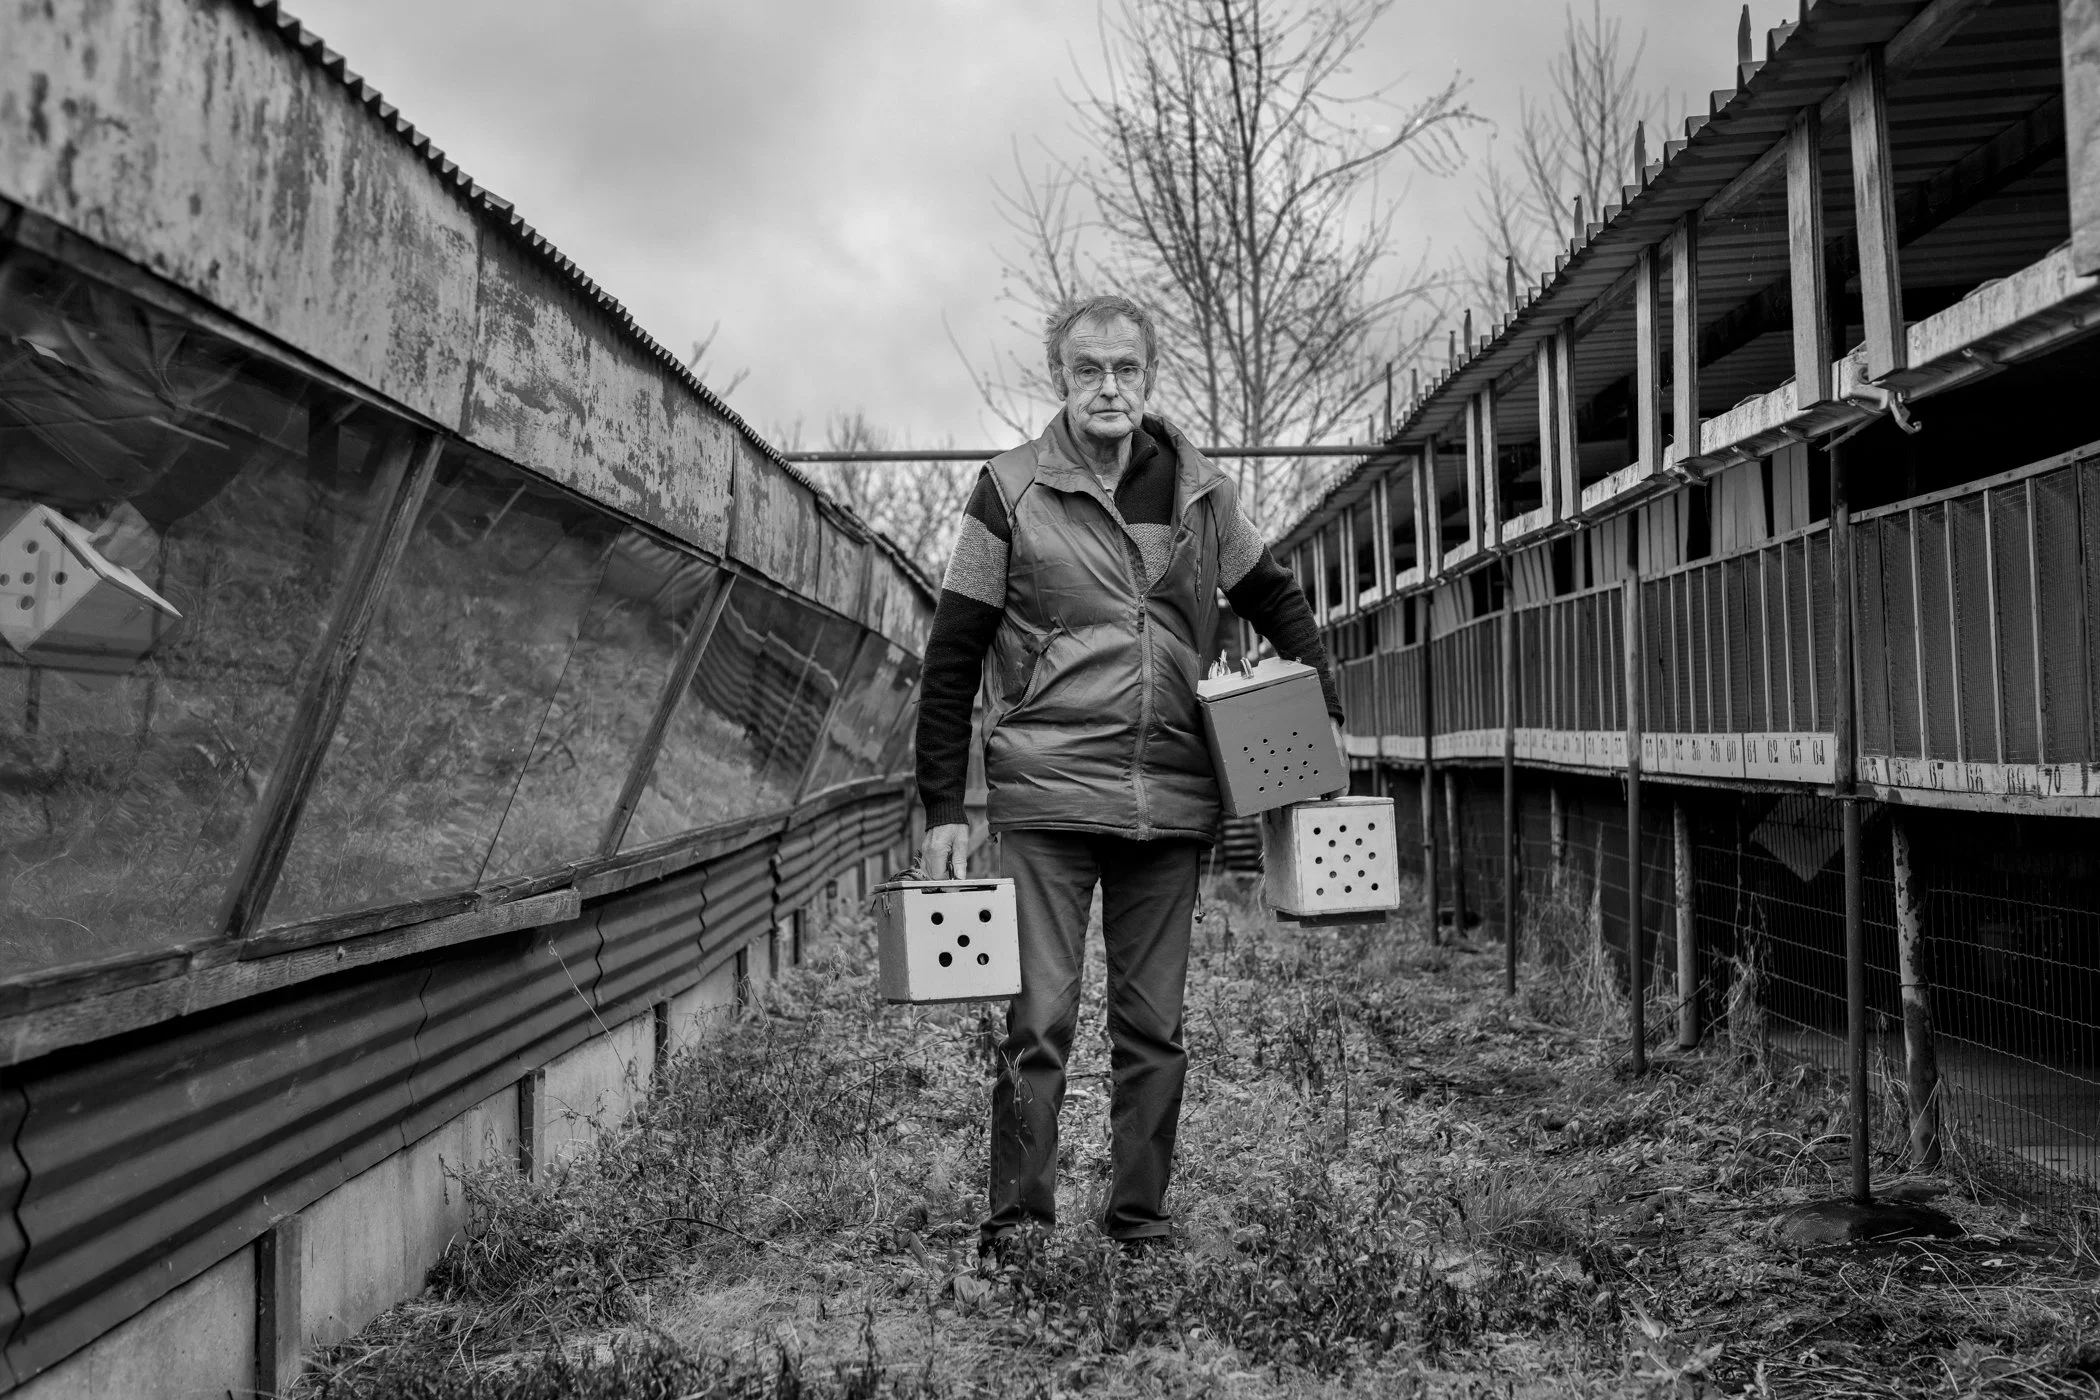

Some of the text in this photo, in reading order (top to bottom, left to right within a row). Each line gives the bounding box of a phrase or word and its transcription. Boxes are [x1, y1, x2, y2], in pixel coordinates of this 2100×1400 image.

[1675, 737, 1683, 761] 57
[1692, 739, 1701, 761] 58
[1710, 740, 1721, 762] 59
[1726, 740, 1737, 762] 60
[1747, 739, 1757, 763] 61
[1767, 739, 1778, 763] 62
[1789, 739, 1801, 764] 63
[1812, 739, 1825, 765] 64
[1928, 761, 1944, 790] 67
[1965, 764, 1983, 792] 68
[2007, 766, 2026, 794] 69
[2041, 765, 2061, 796] 70
